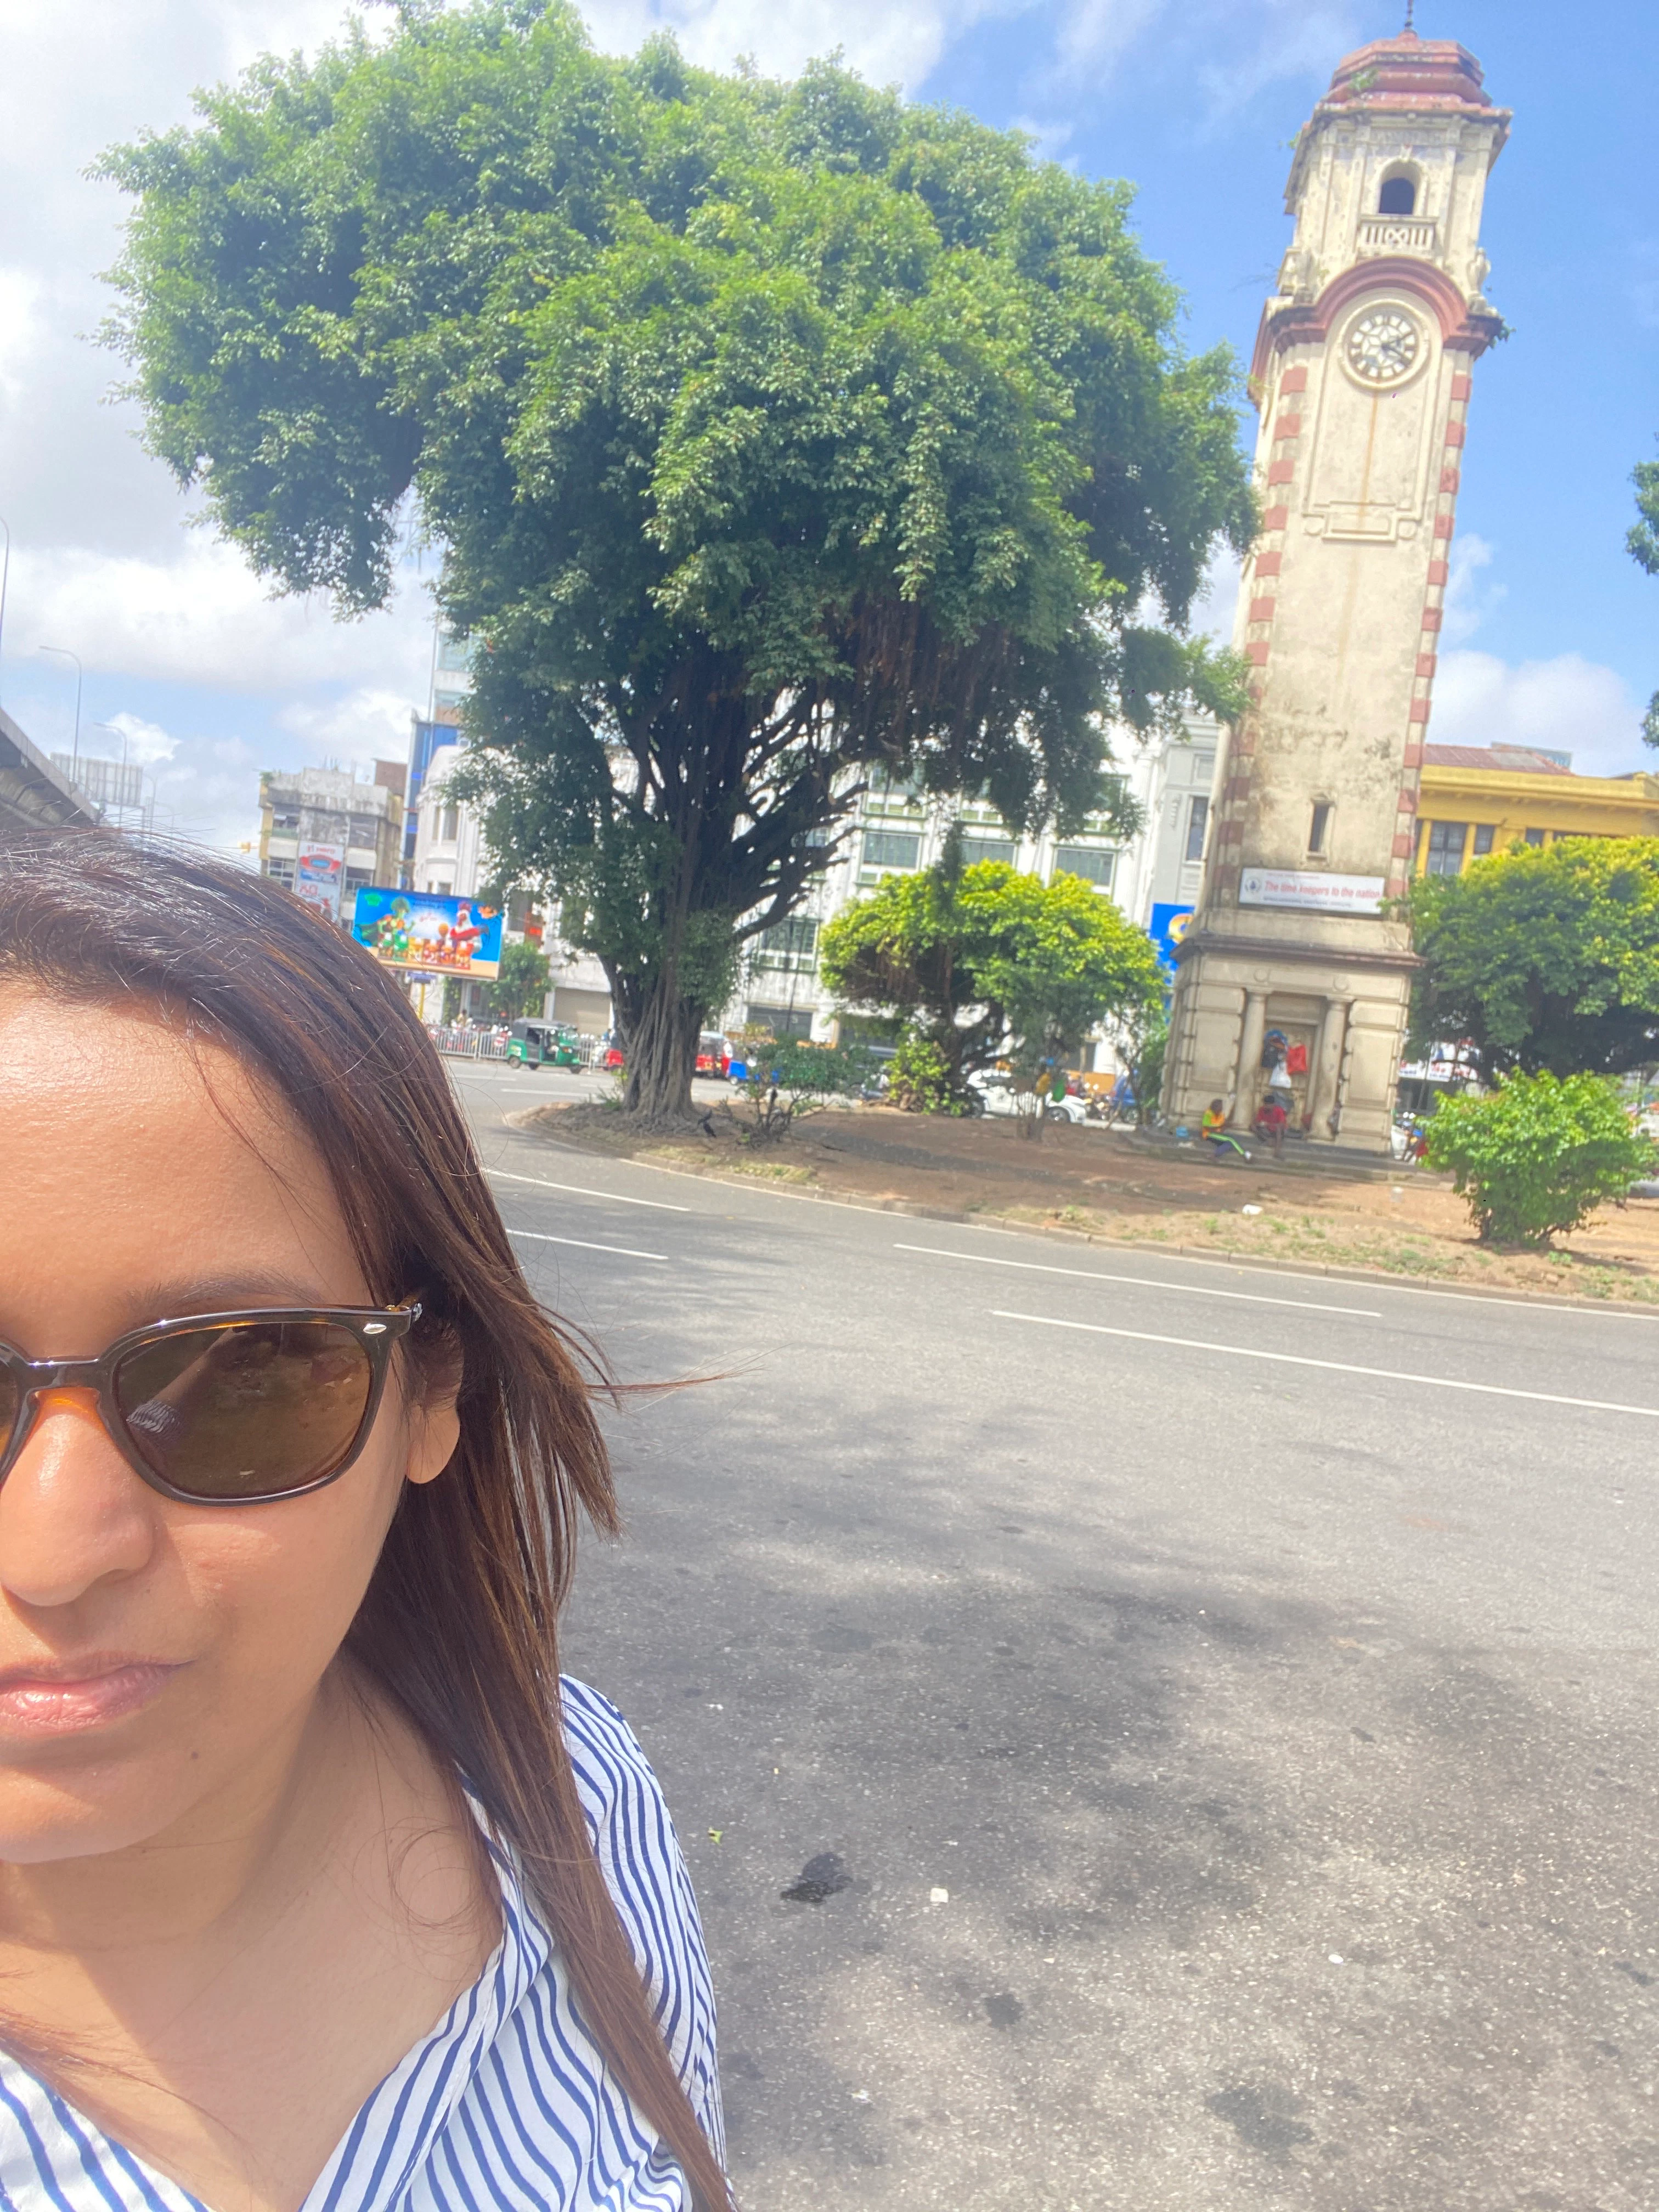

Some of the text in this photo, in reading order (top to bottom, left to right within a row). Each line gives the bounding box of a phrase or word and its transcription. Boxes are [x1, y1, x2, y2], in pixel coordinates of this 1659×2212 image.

[1265, 880, 1382, 898] The time keepers to the nation
